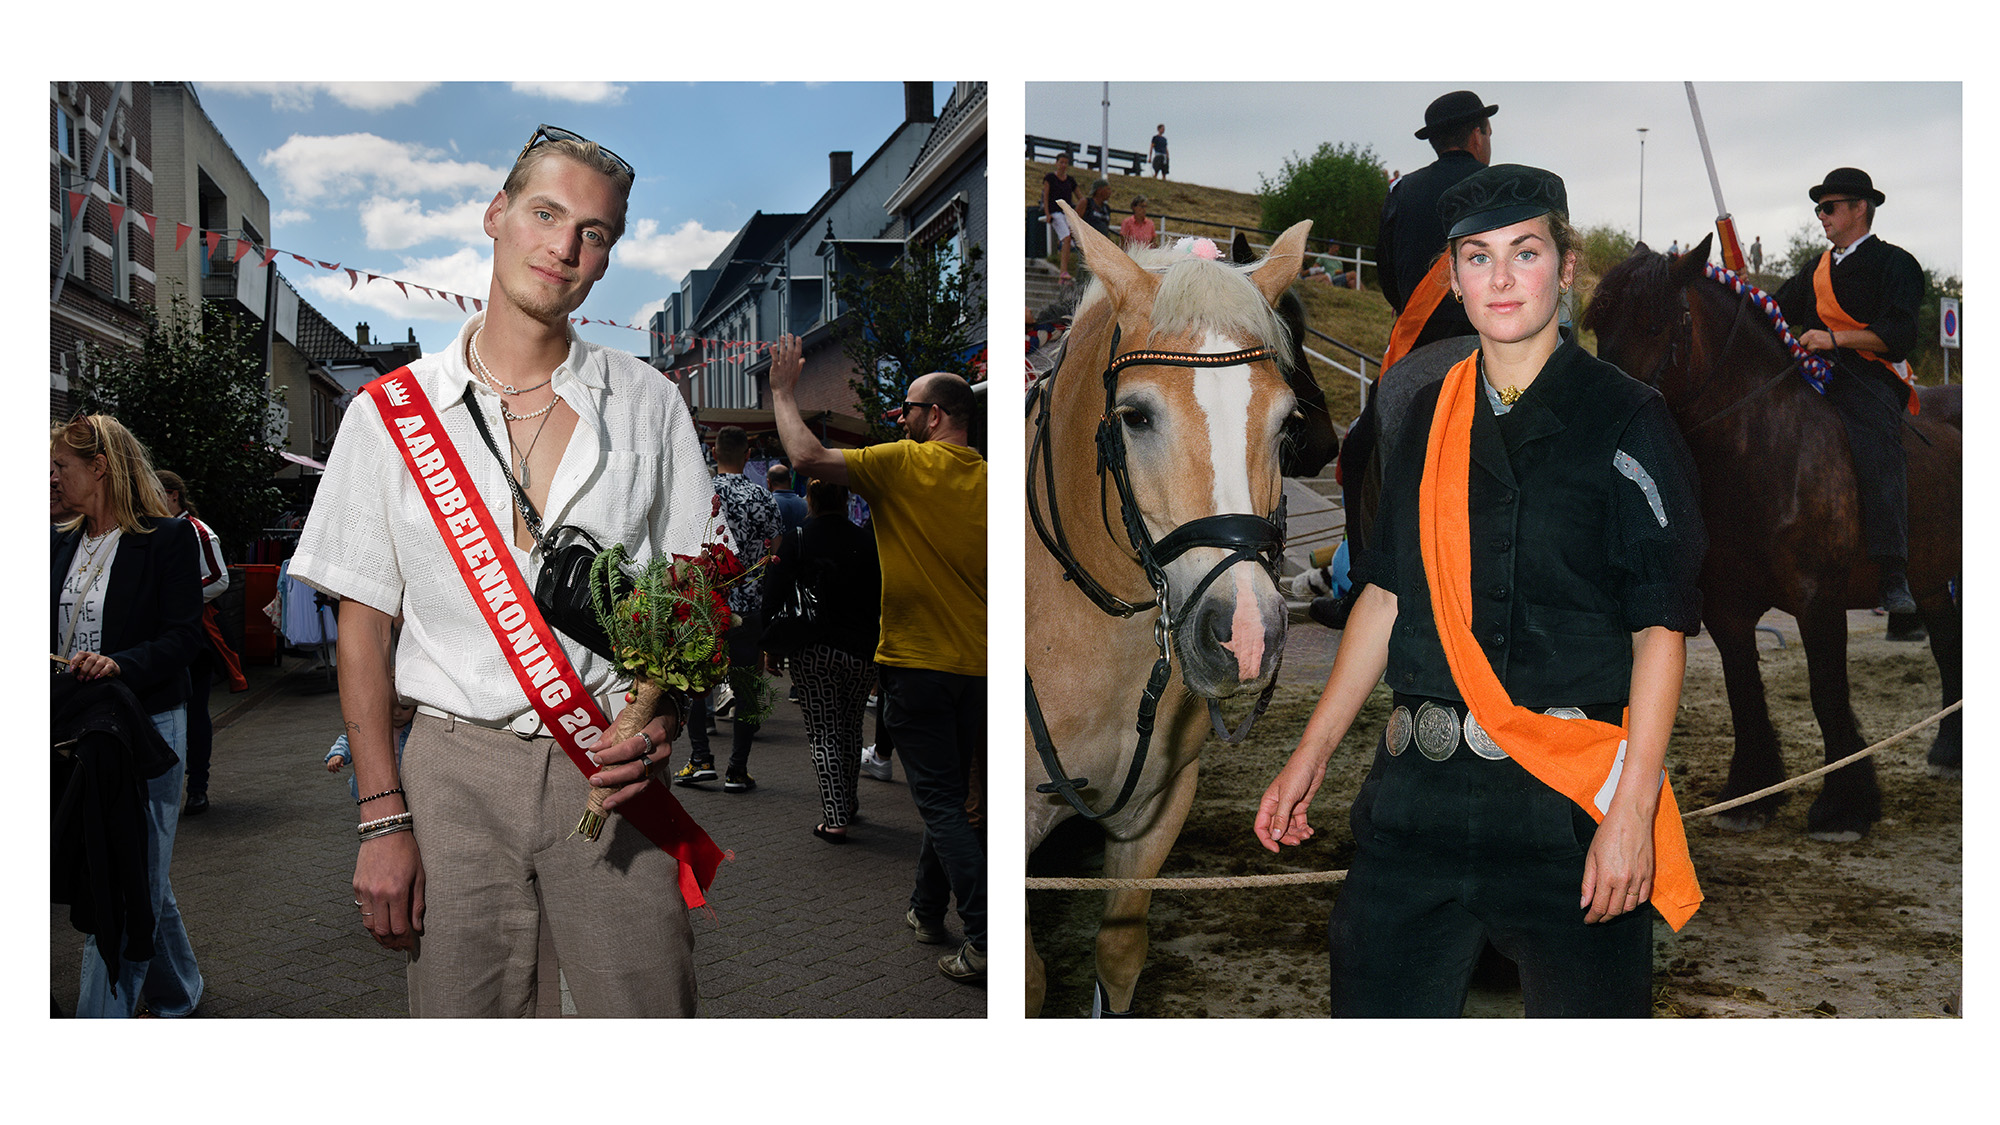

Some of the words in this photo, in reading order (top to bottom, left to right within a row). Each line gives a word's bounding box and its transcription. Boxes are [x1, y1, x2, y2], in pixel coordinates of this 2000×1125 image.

[59, 600, 96, 624] THE
[393, 414, 572, 709] AARDBEIENKONING
[557, 706, 604, 768] 20
